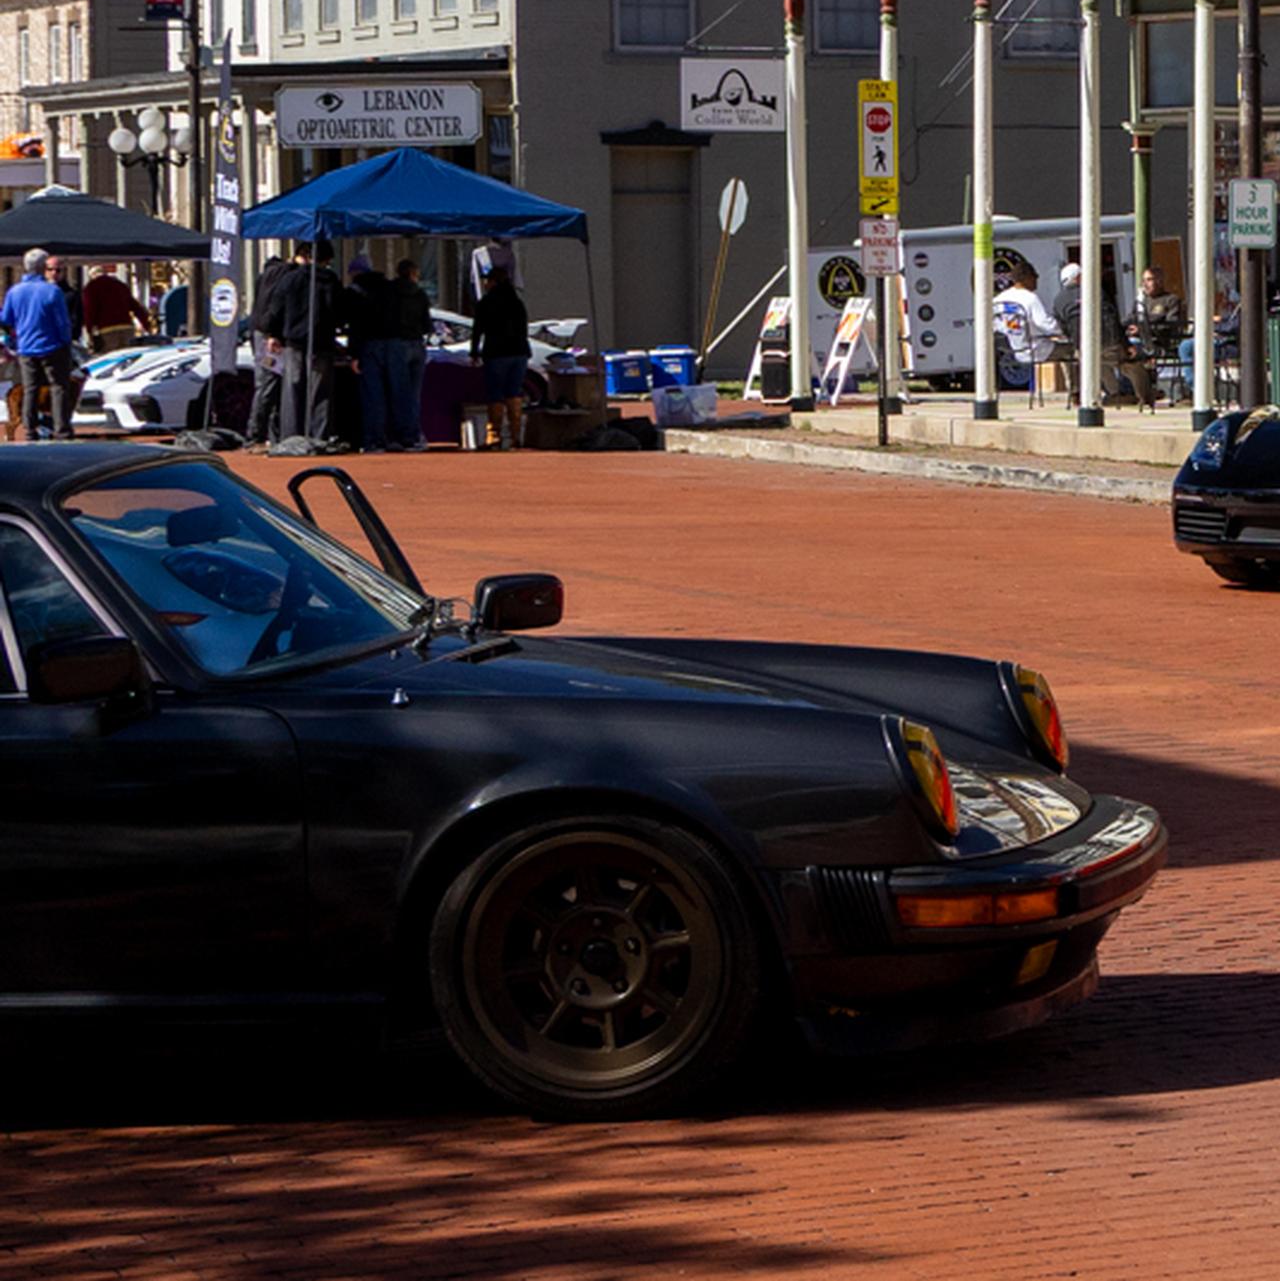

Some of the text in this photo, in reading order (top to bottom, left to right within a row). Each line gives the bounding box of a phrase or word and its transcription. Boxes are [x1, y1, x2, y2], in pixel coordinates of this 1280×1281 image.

[363, 89, 445, 111] LEBANON
[695, 114, 773, 125] Coffee World
[867, 114, 890, 126] STOP
[297, 116, 463, 140] OPTOMETRIC CENTER
[1248, 190, 1257, 204] 3
[1236, 206, 1268, 219] HOUR
[873, 224, 888, 234] NO
[1232, 223, 1273, 236] PARKING
[863, 237, 898, 246] PARKING
